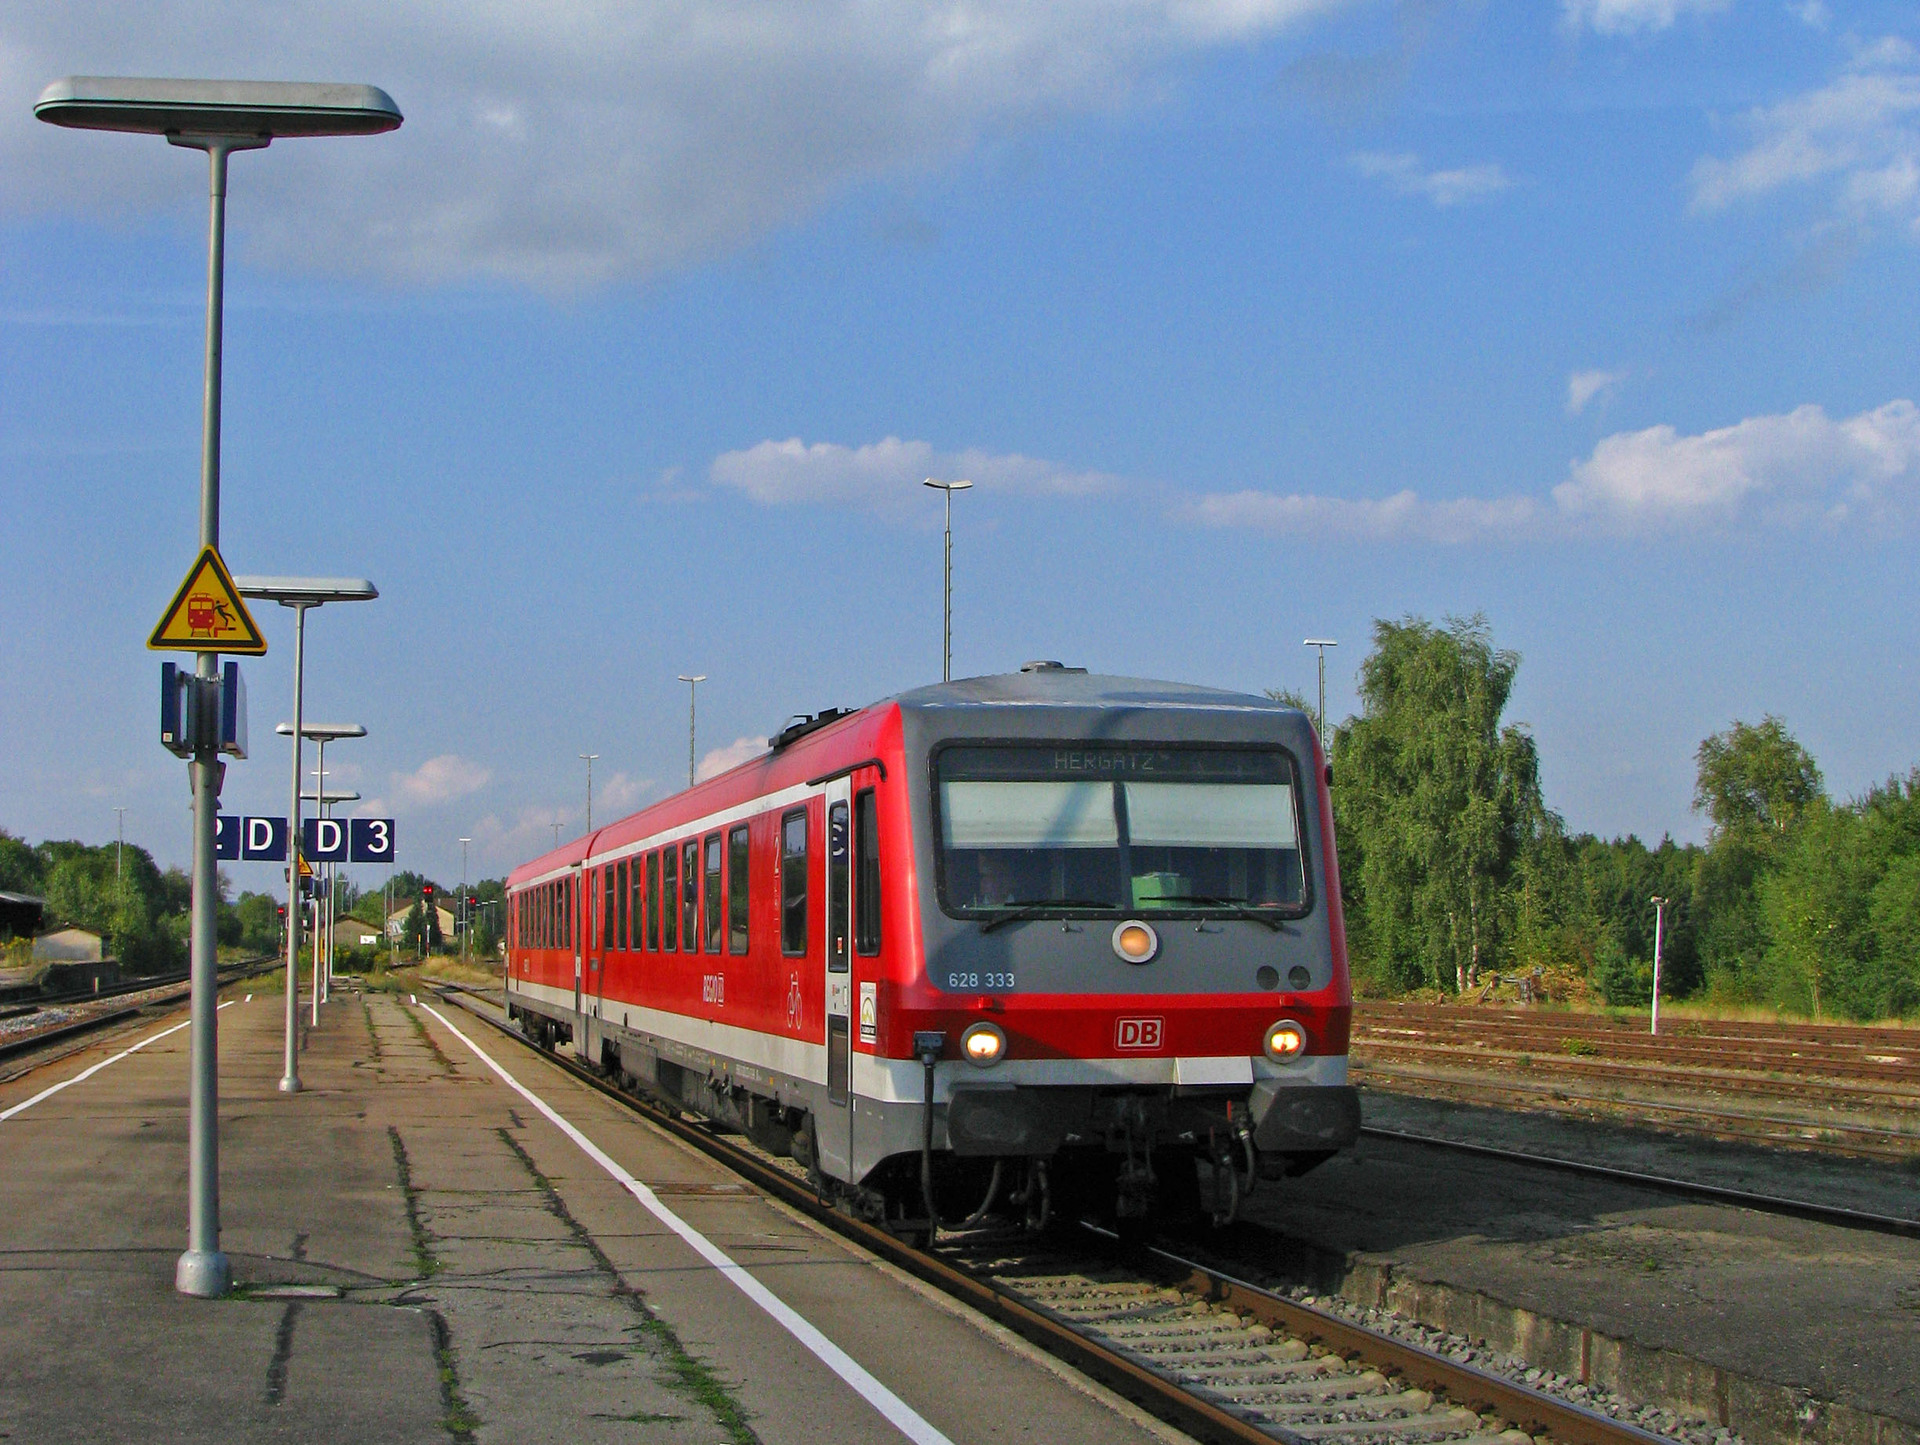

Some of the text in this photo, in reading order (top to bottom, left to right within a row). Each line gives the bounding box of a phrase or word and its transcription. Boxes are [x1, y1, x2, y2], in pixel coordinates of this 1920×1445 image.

[248, 818, 274, 850] D
[317, 820, 389, 853] D 3
[949, 973, 1015, 987] 628 333
[1121, 1022, 1158, 1045] DB
